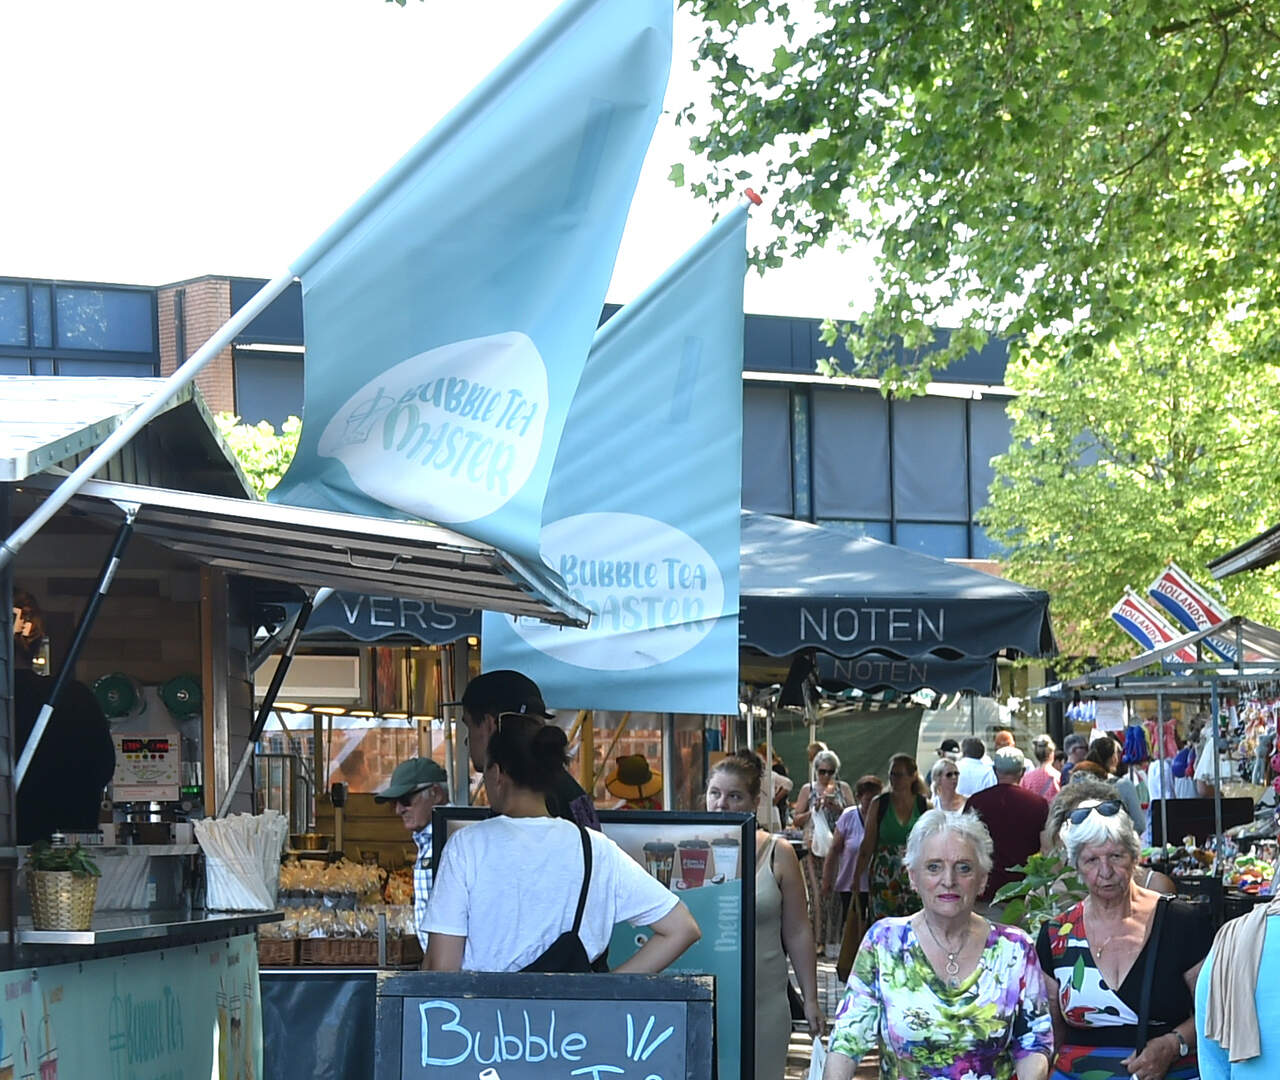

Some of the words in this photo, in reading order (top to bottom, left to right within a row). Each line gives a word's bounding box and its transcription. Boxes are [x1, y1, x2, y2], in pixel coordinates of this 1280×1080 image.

[336, 594, 457, 630] VERS
[1156, 580, 1208, 626] HOLLANDSE
[800, 607, 944, 642] NOTEN
[833, 659, 928, 683] NOTEN
[419, 1000, 588, 1067] Bubble
